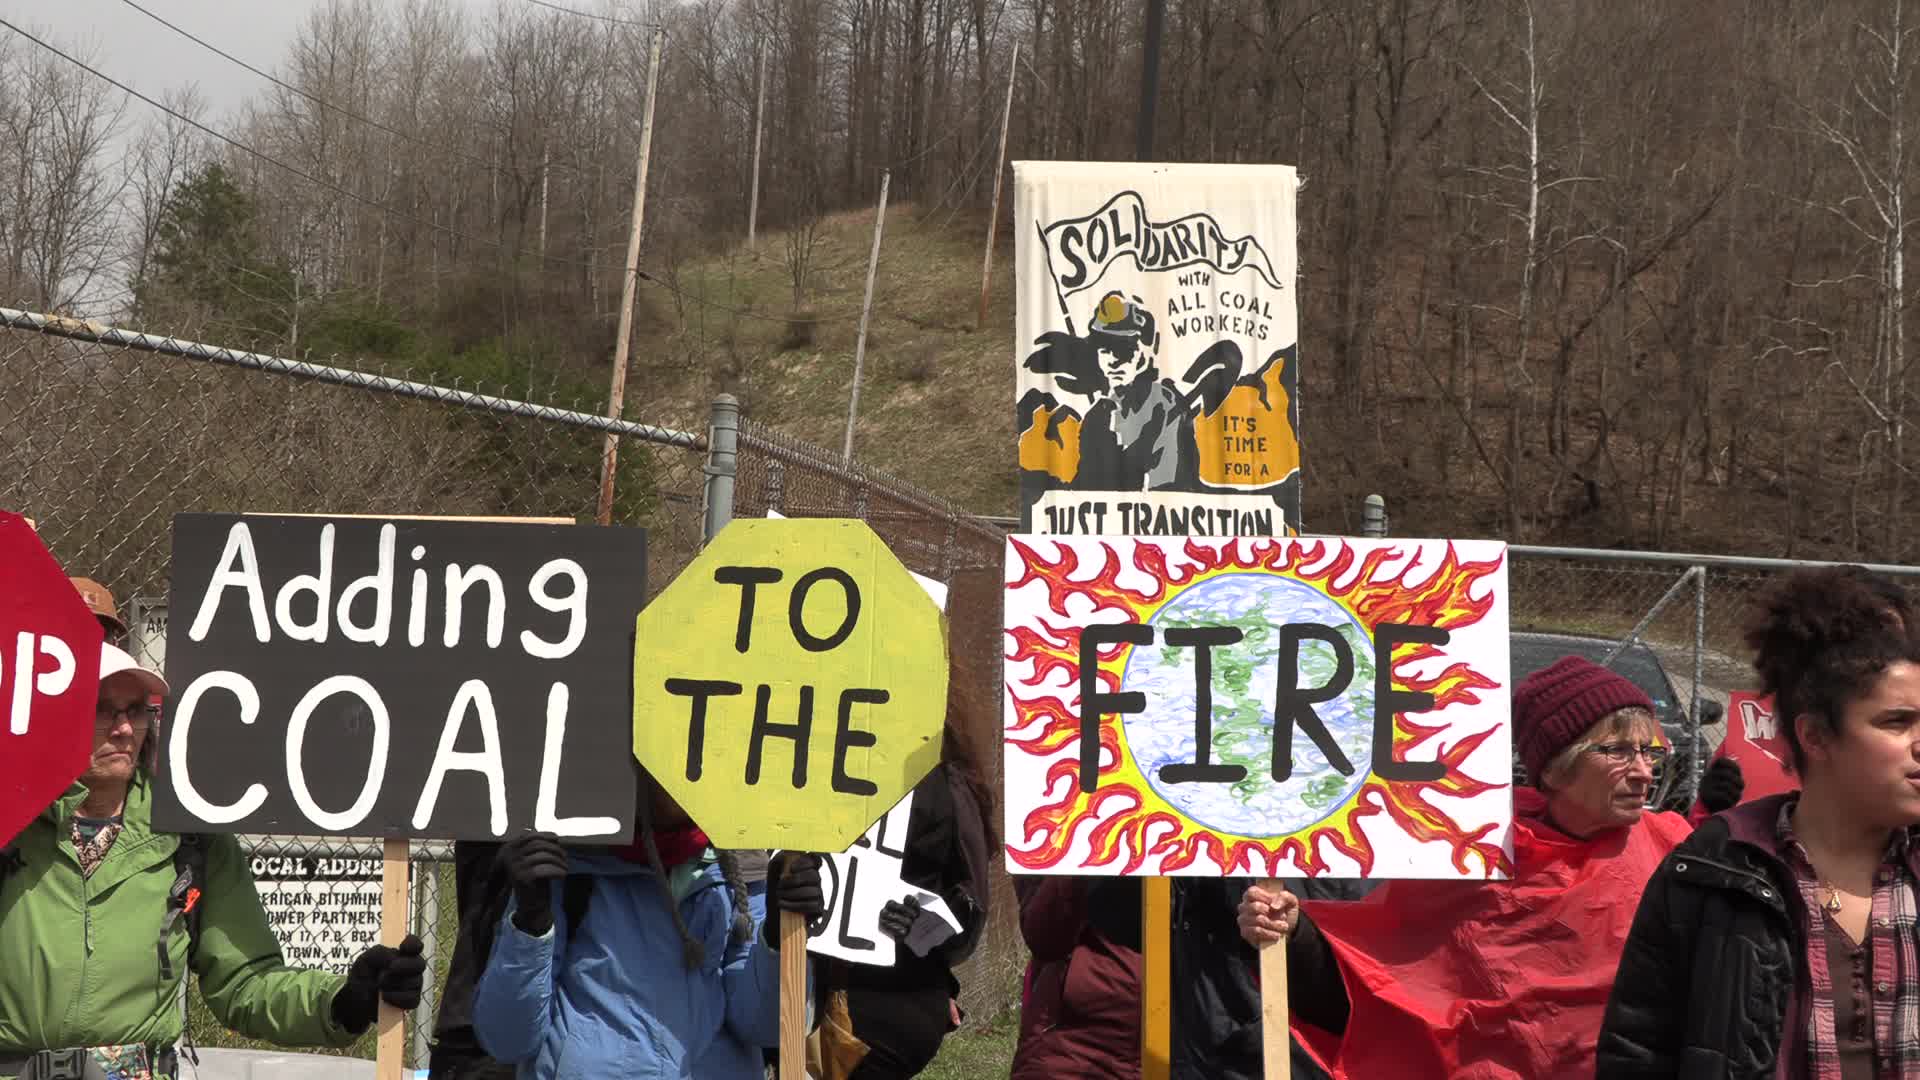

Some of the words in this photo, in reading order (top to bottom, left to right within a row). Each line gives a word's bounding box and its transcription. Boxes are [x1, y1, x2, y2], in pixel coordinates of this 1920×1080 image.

[1060, 204, 1248, 288] SOLIDARITY
[1178, 271, 1210, 287] WITH
[1168, 292, 1206, 317] ALL
[1220, 291, 1272, 320] COAL
[1171, 314, 1269, 341] WORKERS
[1223, 416, 1257, 433] IT'S
[1223, 437, 1267, 452] TIME
[1224, 463, 1251, 476] FOR
[1260, 463, 1270, 476] A
[1041, 501, 1107, 535] JUST
[1117, 502, 1273, 536] TRANSITION
[188, 521, 588, 659] Adding
[714, 566, 862, 653] TO
[0, 632, 76, 736] P
[1078, 622, 1451, 793] FIRE
[664, 678, 890, 796] THE
[168, 670, 621, 836] COAL
[250, 856, 308, 876] OCAL
[259, 892, 312, 906] ERICAN
[351, 930, 375, 942] BOX
